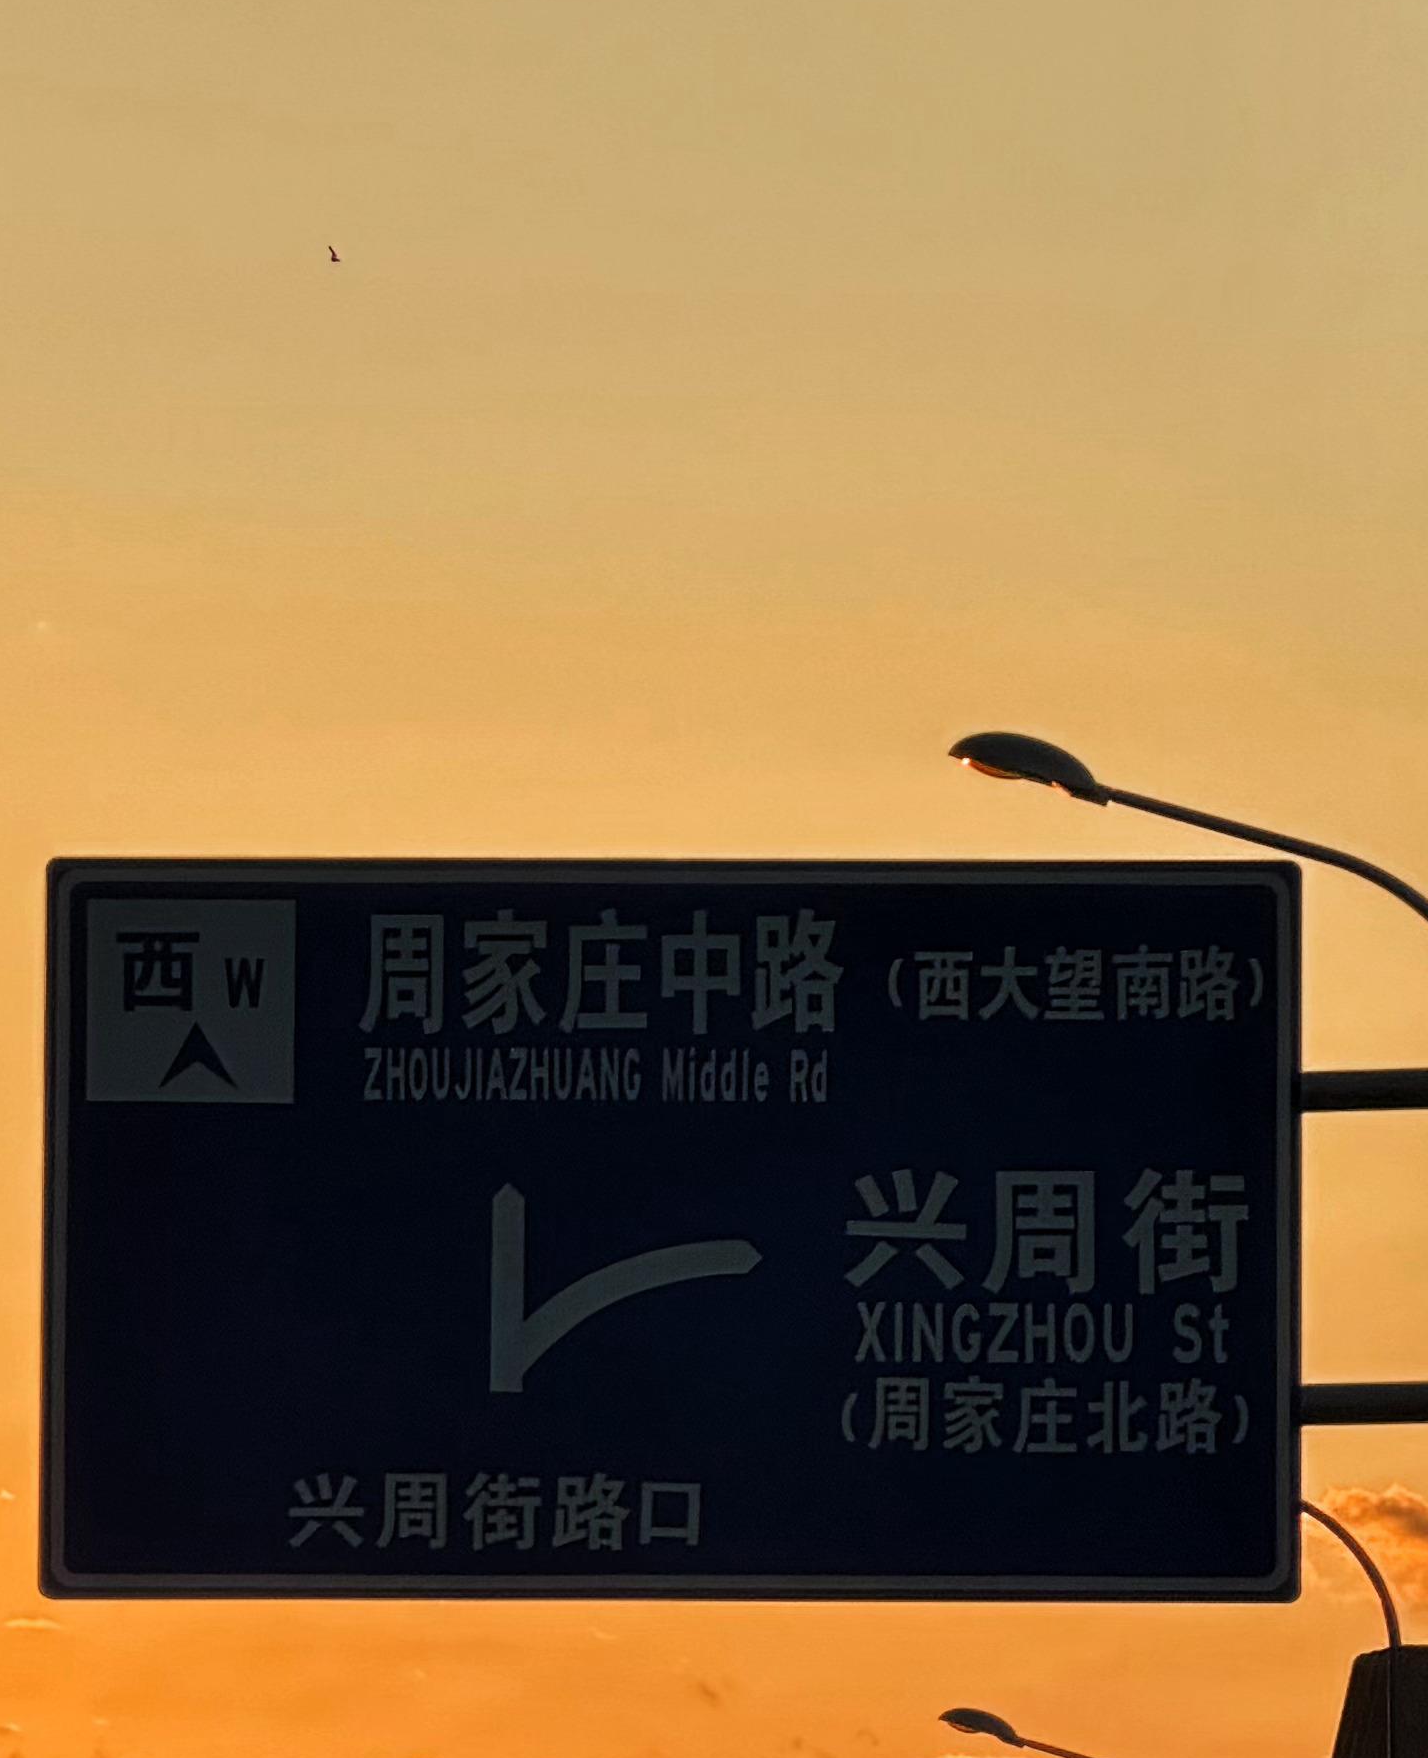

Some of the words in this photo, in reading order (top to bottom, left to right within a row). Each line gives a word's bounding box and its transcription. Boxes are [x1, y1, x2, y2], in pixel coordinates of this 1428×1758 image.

[115, 930, 201, 1013] 西
[224, 956, 266, 1010] W
[358, 908, 844, 1035] 周家庄中路
[886, 943, 1265, 1022] (西大望南路)
[363, 1046, 642, 1103] ZHOUJIAZHUANG
[661, 1046, 770, 1103] Middle
[789, 1048, 829, 1104] Rd
[843, 1168, 1250, 1295] 兴周街
[854, 1301, 1135, 1364] XINGZHOU
[1172, 1302, 1230, 1364] St
[839, 1376, 1250, 1455] (周家庄北路)
[287, 1472, 702, 1552] 兴周街路口
